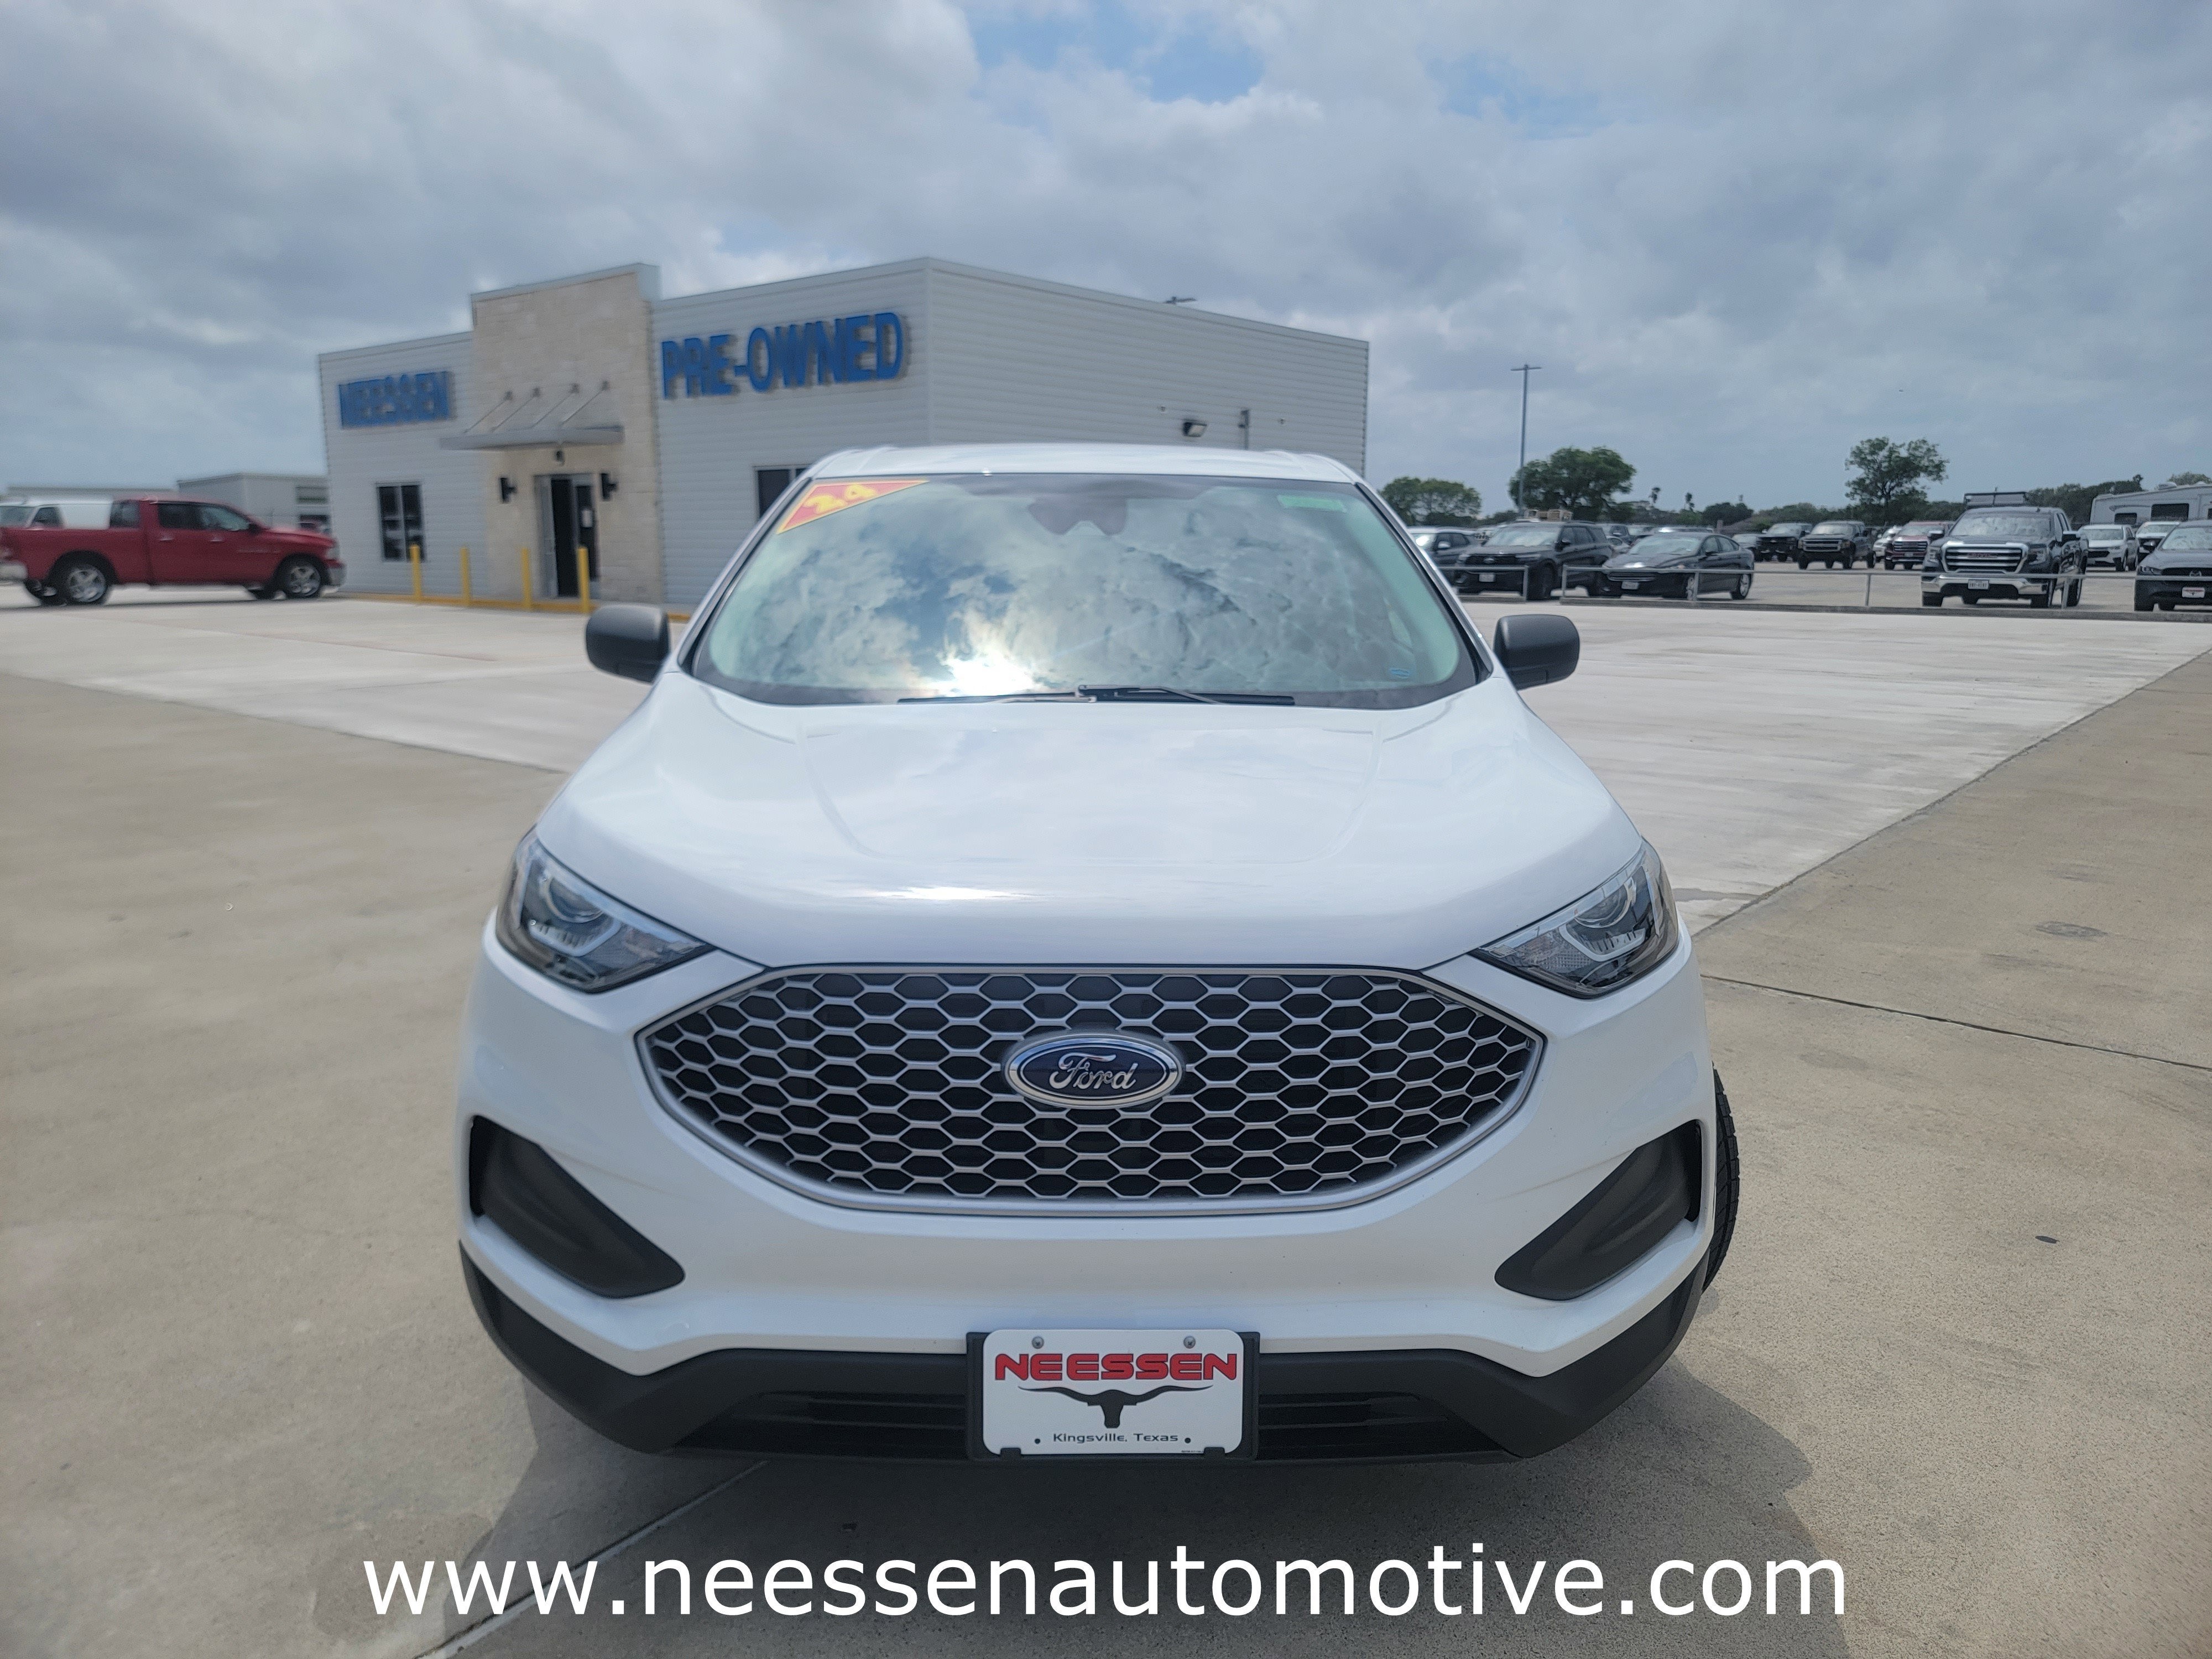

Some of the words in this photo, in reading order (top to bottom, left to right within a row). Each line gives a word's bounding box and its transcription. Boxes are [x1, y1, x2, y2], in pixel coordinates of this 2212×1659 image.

[661, 312, 903, 398] PRE-OWNED
[1048, 1052, 1139, 1090] Ford
[995, 1353, 1237, 1380] NEESSEN
[1134, 1433, 1178, 1442] Texas
